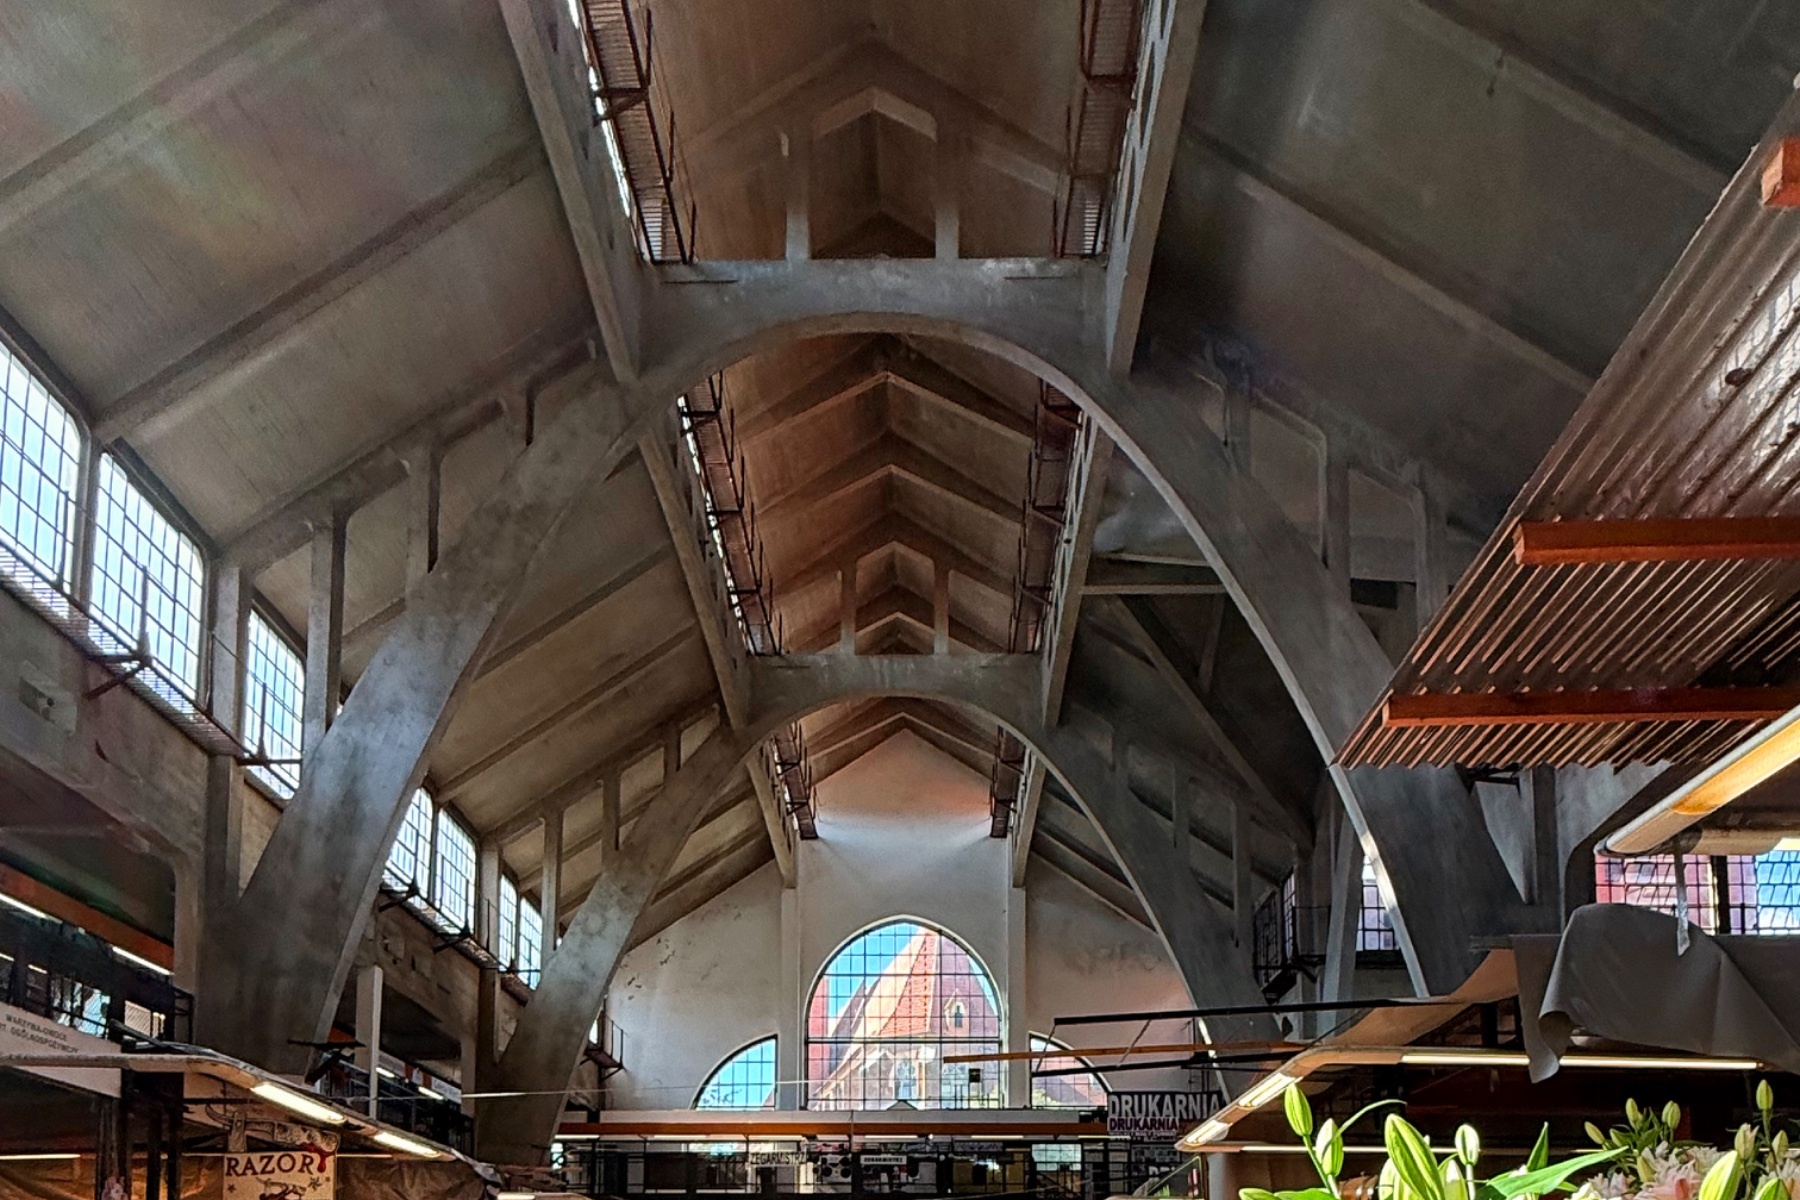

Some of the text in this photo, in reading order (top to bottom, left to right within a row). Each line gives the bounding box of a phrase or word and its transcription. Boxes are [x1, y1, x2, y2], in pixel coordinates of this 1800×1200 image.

[1108, 1093, 1221, 1120] DRUKARNIA
[1109, 1117, 1179, 1131] DRUKARNIA
[225, 1154, 314, 1177] RAZOR
